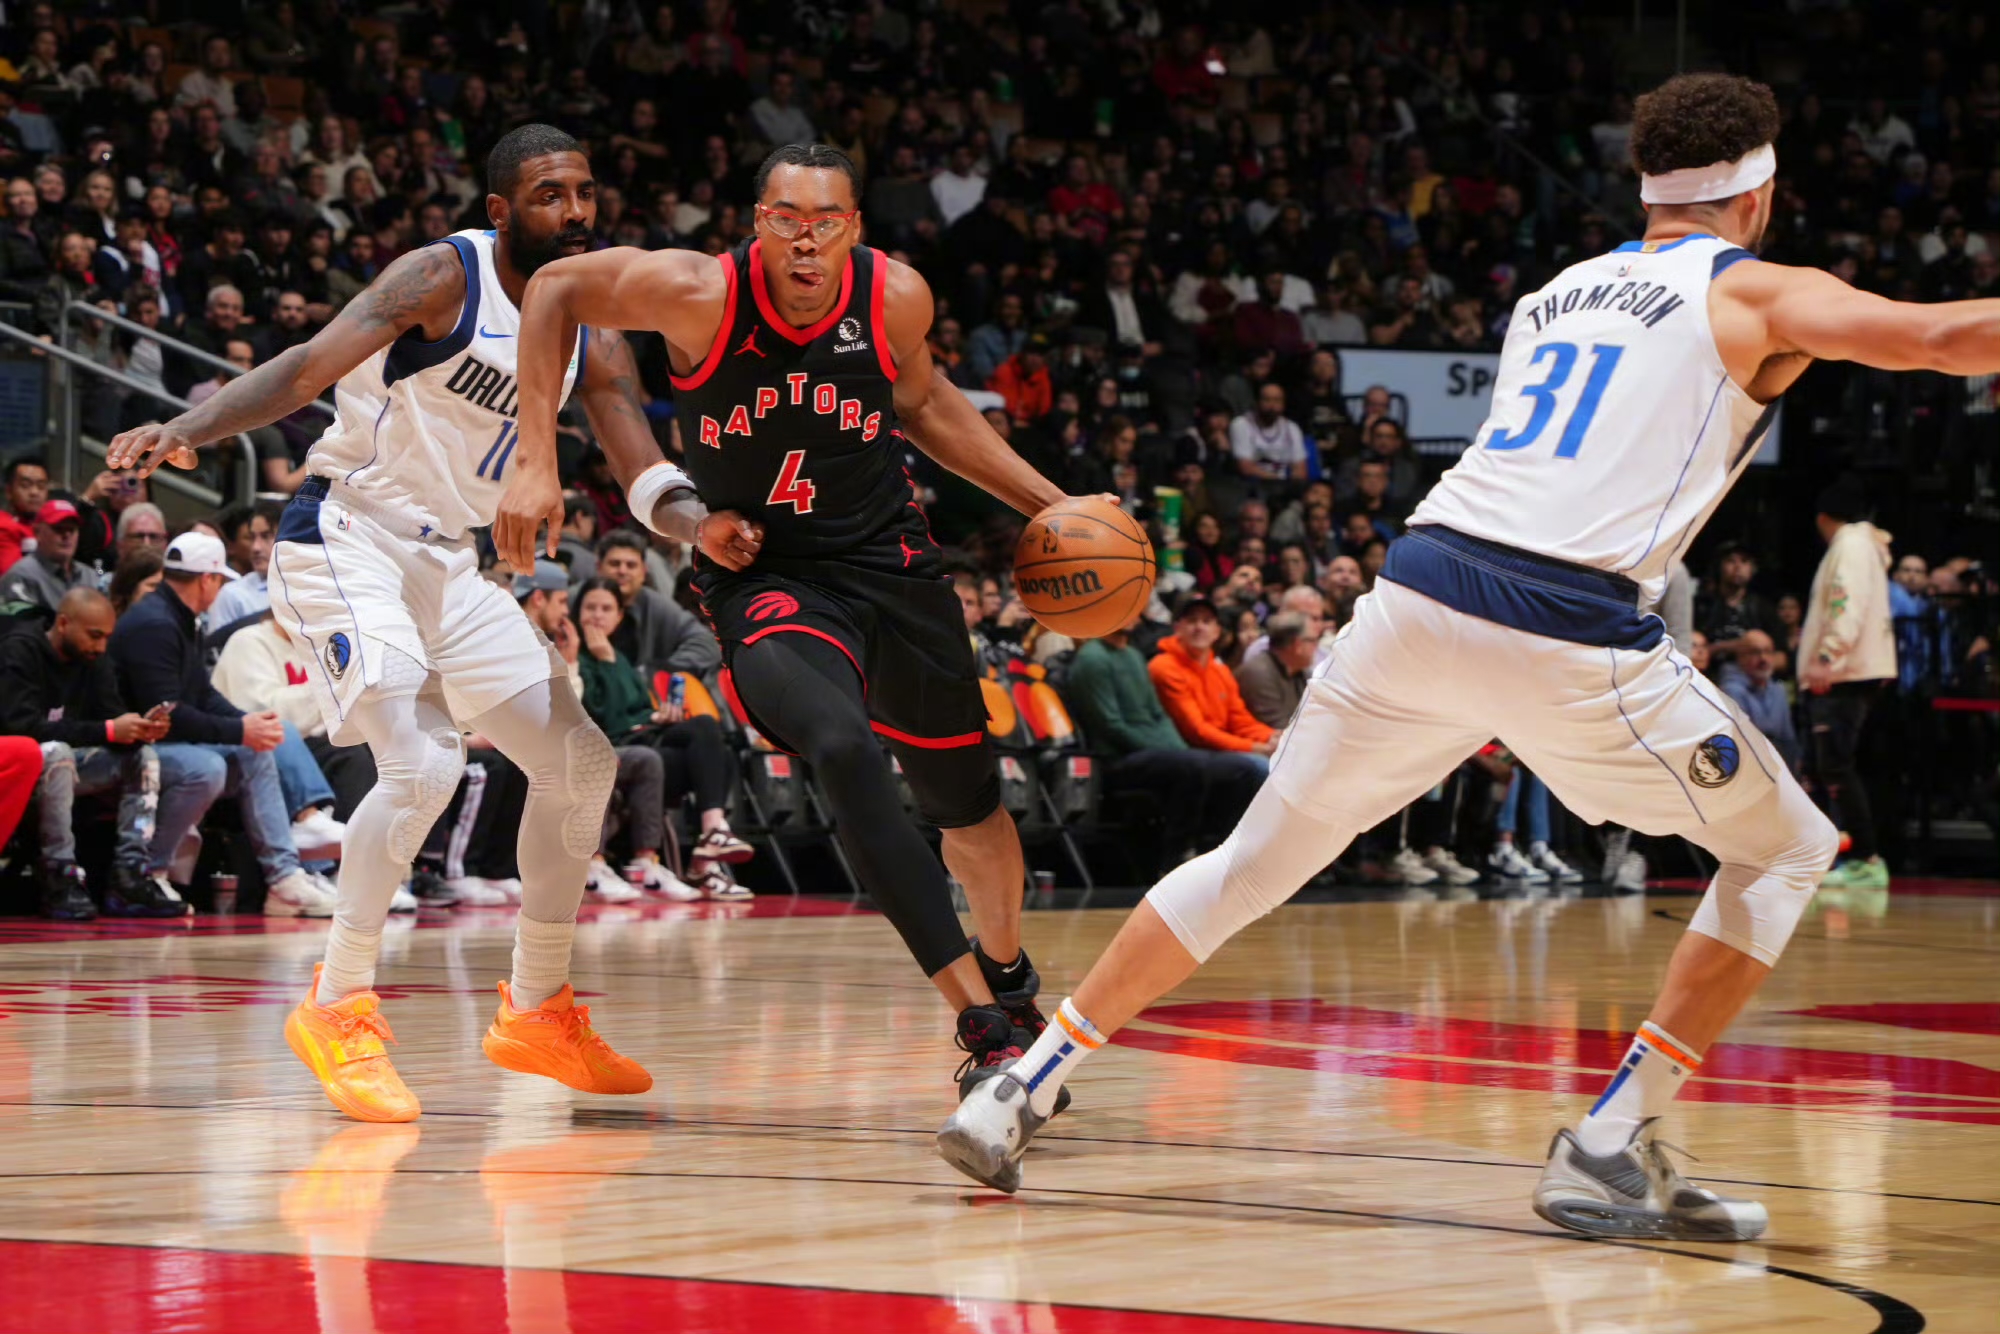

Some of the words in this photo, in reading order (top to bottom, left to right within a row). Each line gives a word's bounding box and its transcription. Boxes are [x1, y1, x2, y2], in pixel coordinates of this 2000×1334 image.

[1527, 281, 1685, 333] THOMPSON
[833, 344, 851, 354] Sun
[851, 340, 868, 351] Life
[1446, 361, 1496, 397] SP
[1484, 341, 1627, 460] 31
[700, 372, 881, 449] RAPTORS
[476, 419, 518, 481] 11
[765, 449, 816, 515] 4
[1019, 569, 1104, 600] Wilson
